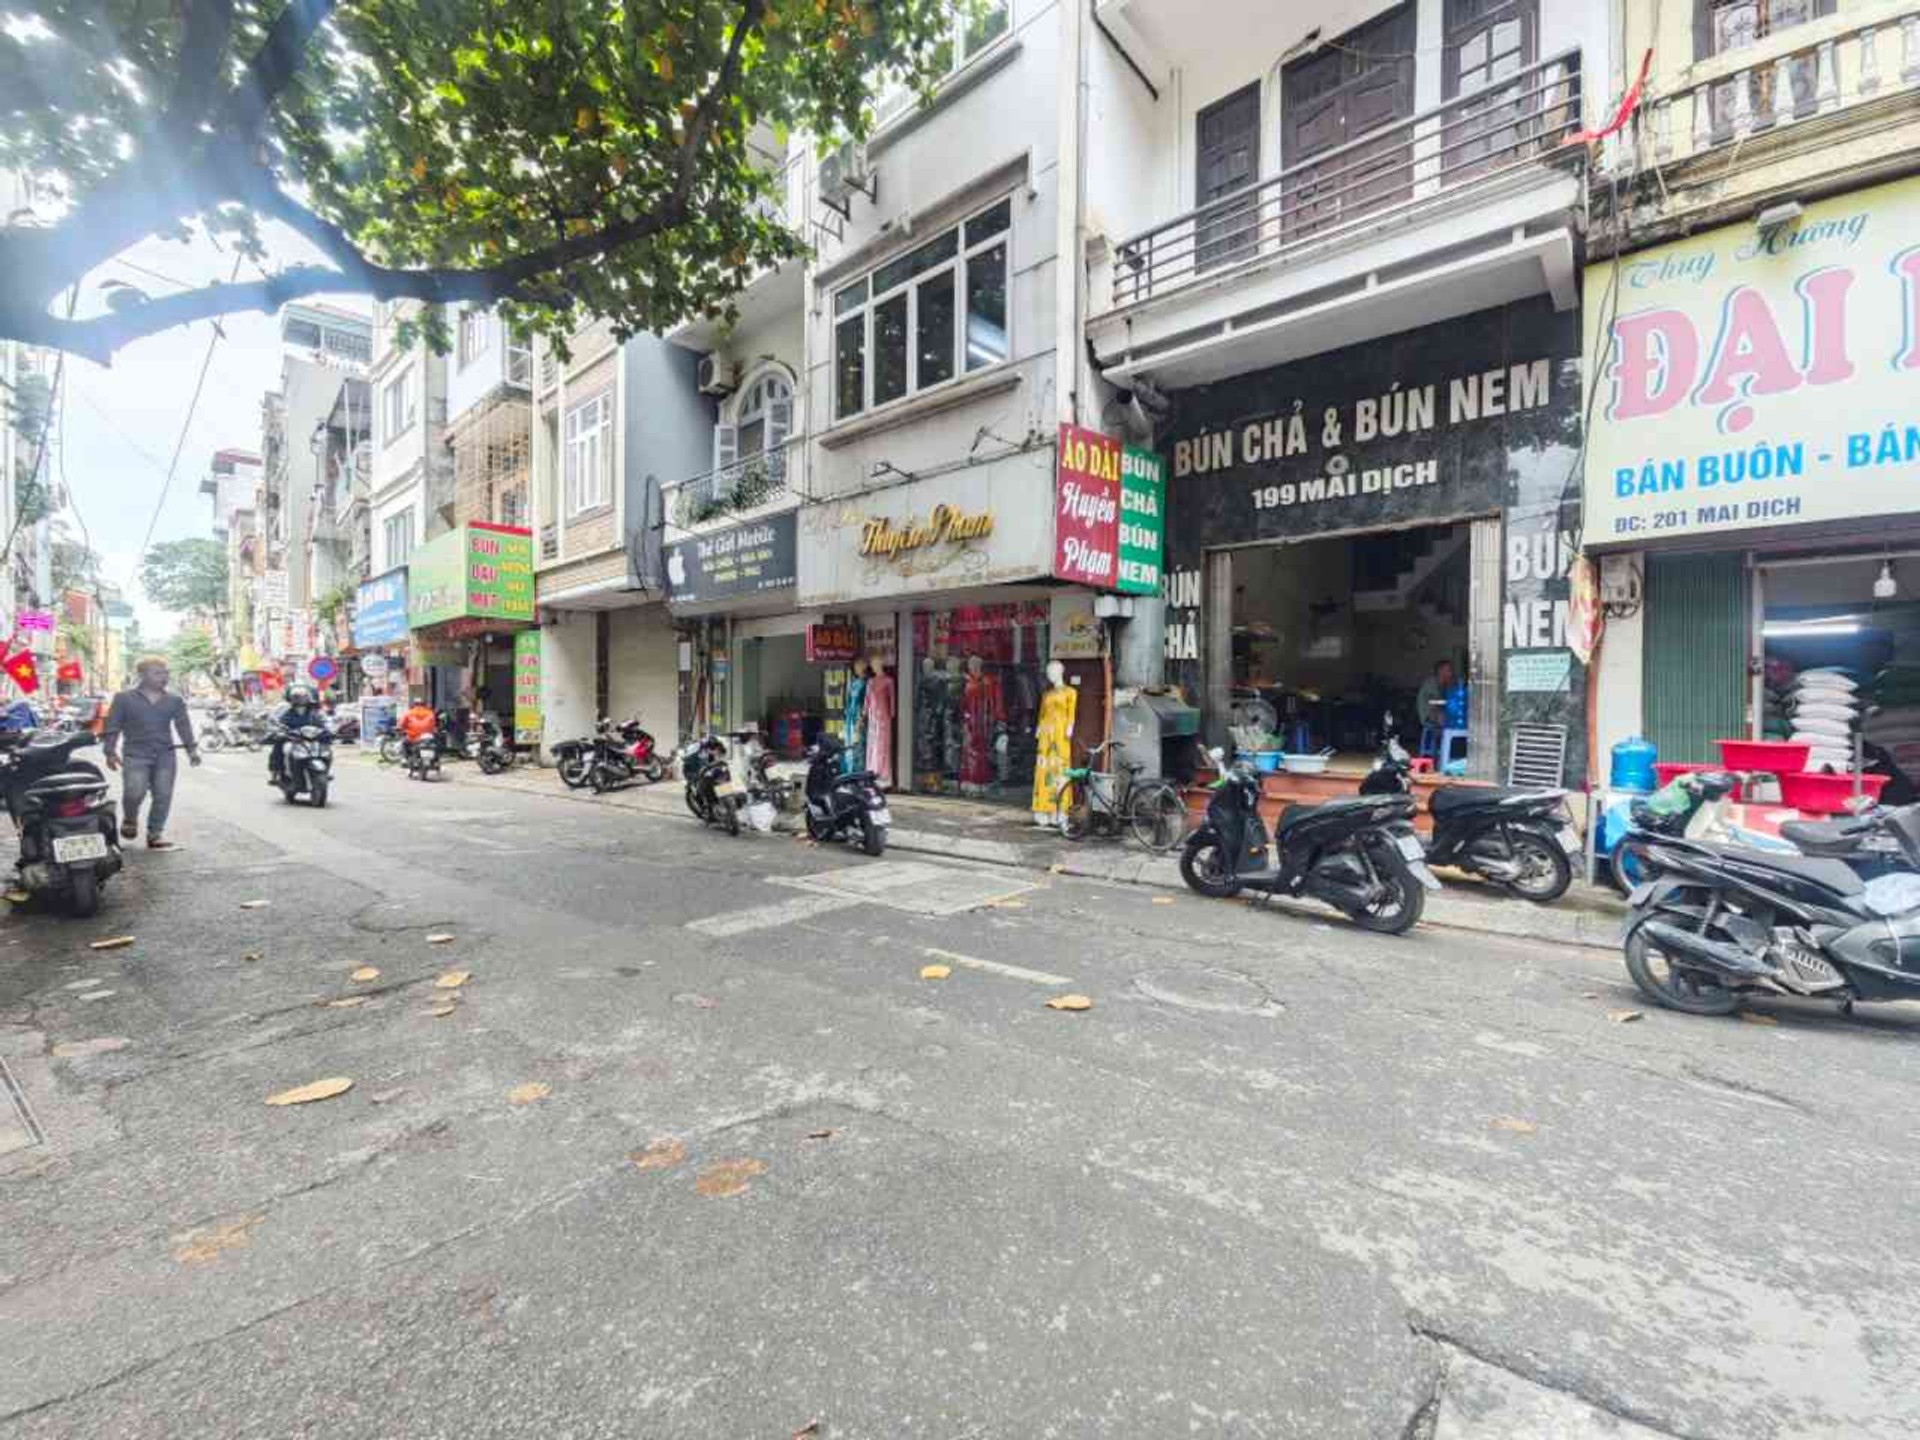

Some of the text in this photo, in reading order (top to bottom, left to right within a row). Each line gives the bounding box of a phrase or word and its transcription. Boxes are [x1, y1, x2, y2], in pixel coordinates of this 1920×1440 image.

[1605, 264, 1855, 434] ĐẠI
[1175, 358, 1550, 478] BÚN CHẢ & BÚN NEM
[1061, 429, 1119, 482] ÁO DÀI
[1120, 453, 1160, 483] BÚN
[1615, 458, 1684, 498] BÁN
[1696, 440, 1804, 488] BUÔN
[1120, 488, 1159, 518] CHẢ
[1251, 484, 1297, 510] 199
[1361, 459, 1438, 495] DỊCH
[1117, 522, 1158, 551] BÚN
[1653, 510, 1688, 528] 201
[1697, 503, 1739, 524] MAI
[1062, 536, 1113, 582] Phạm
